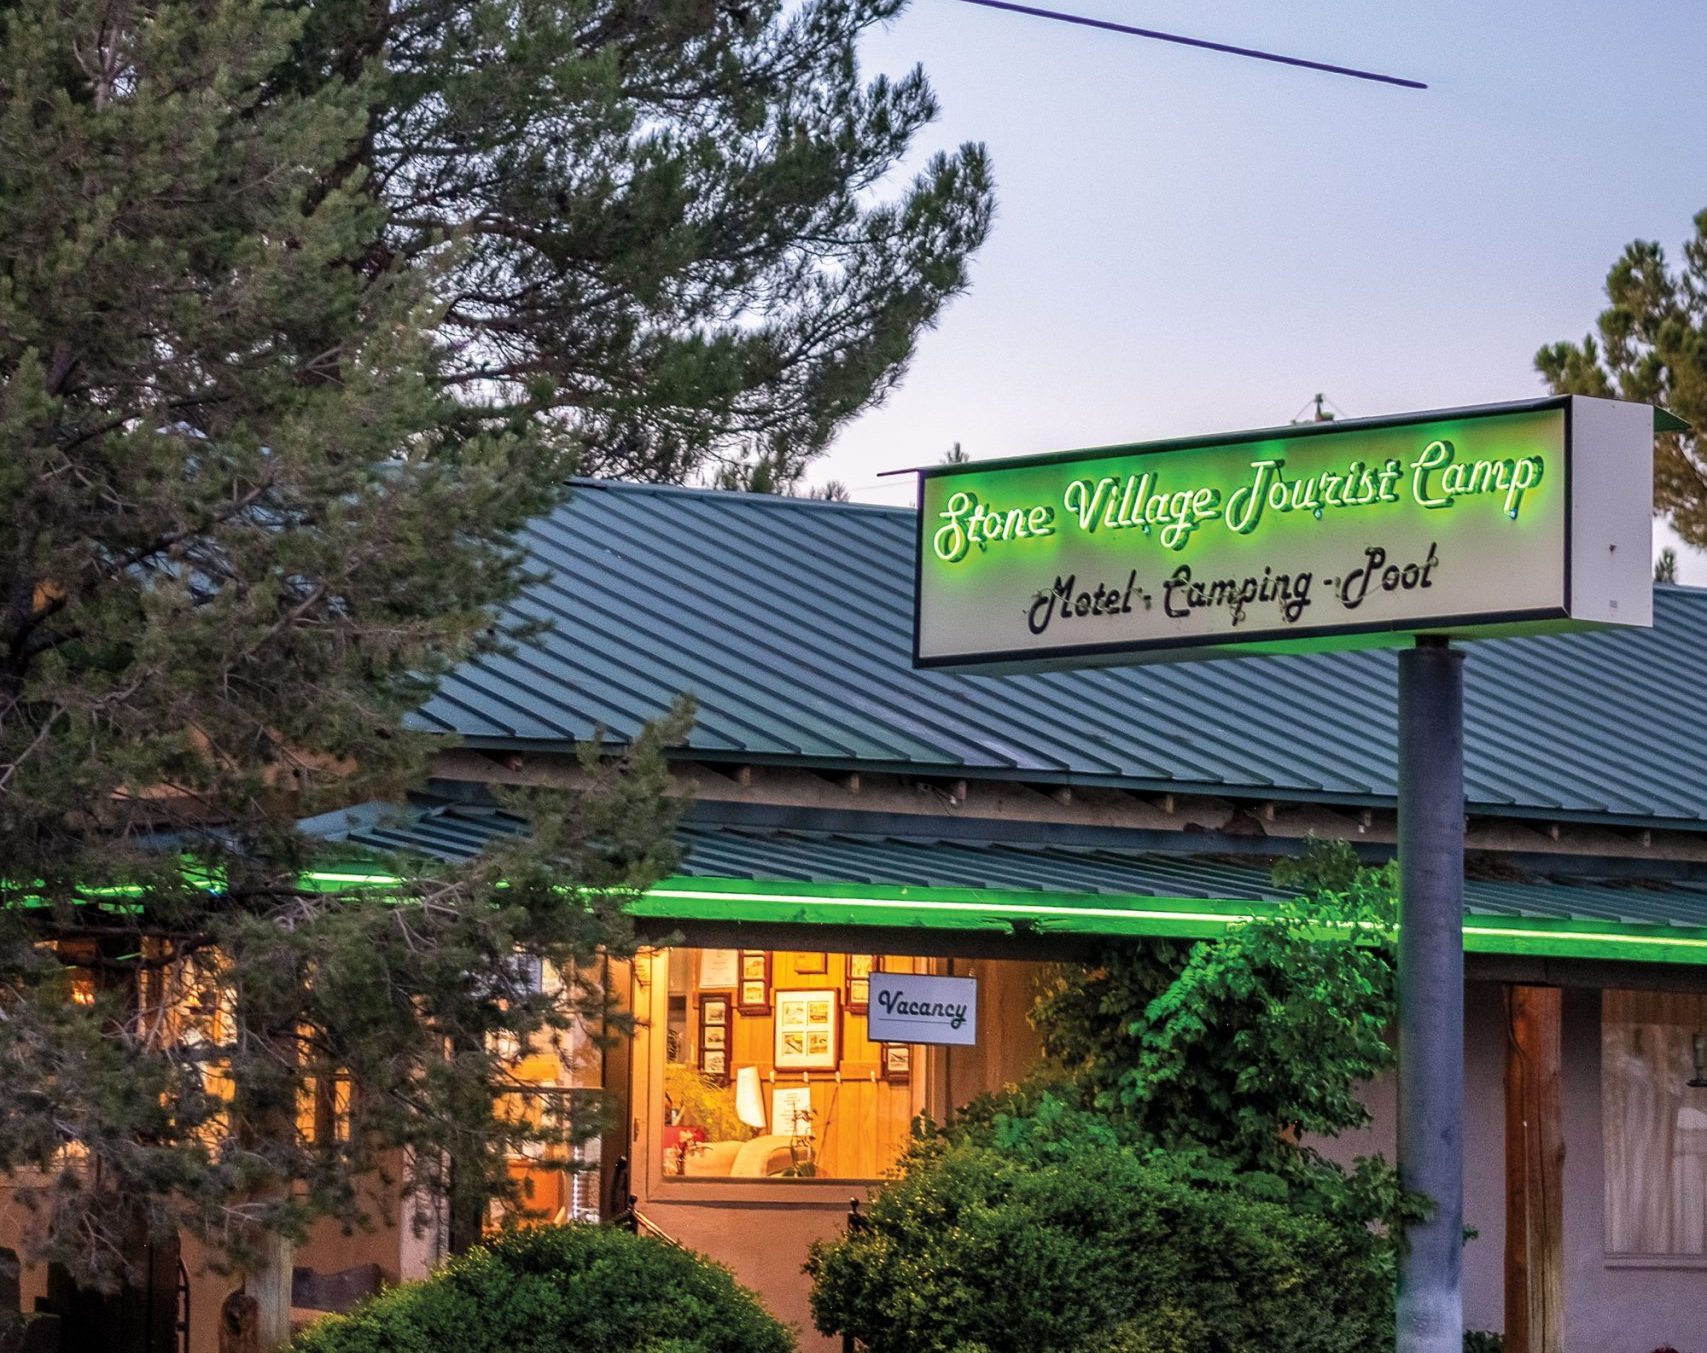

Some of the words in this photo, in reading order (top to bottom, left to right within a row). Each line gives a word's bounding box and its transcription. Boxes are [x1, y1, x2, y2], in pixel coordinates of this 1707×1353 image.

[934, 492, 1053, 561] Stone
[1064, 473, 1220, 549] Village
[1225, 458, 1401, 533] Tourist
[1411, 441, 1543, 519] Camp
[1028, 569, 1137, 634] Motel
[1163, 564, 1313, 627] Camping
[1342, 542, 1438, 609] Pool
[878, 990, 967, 1029] Vacancy
